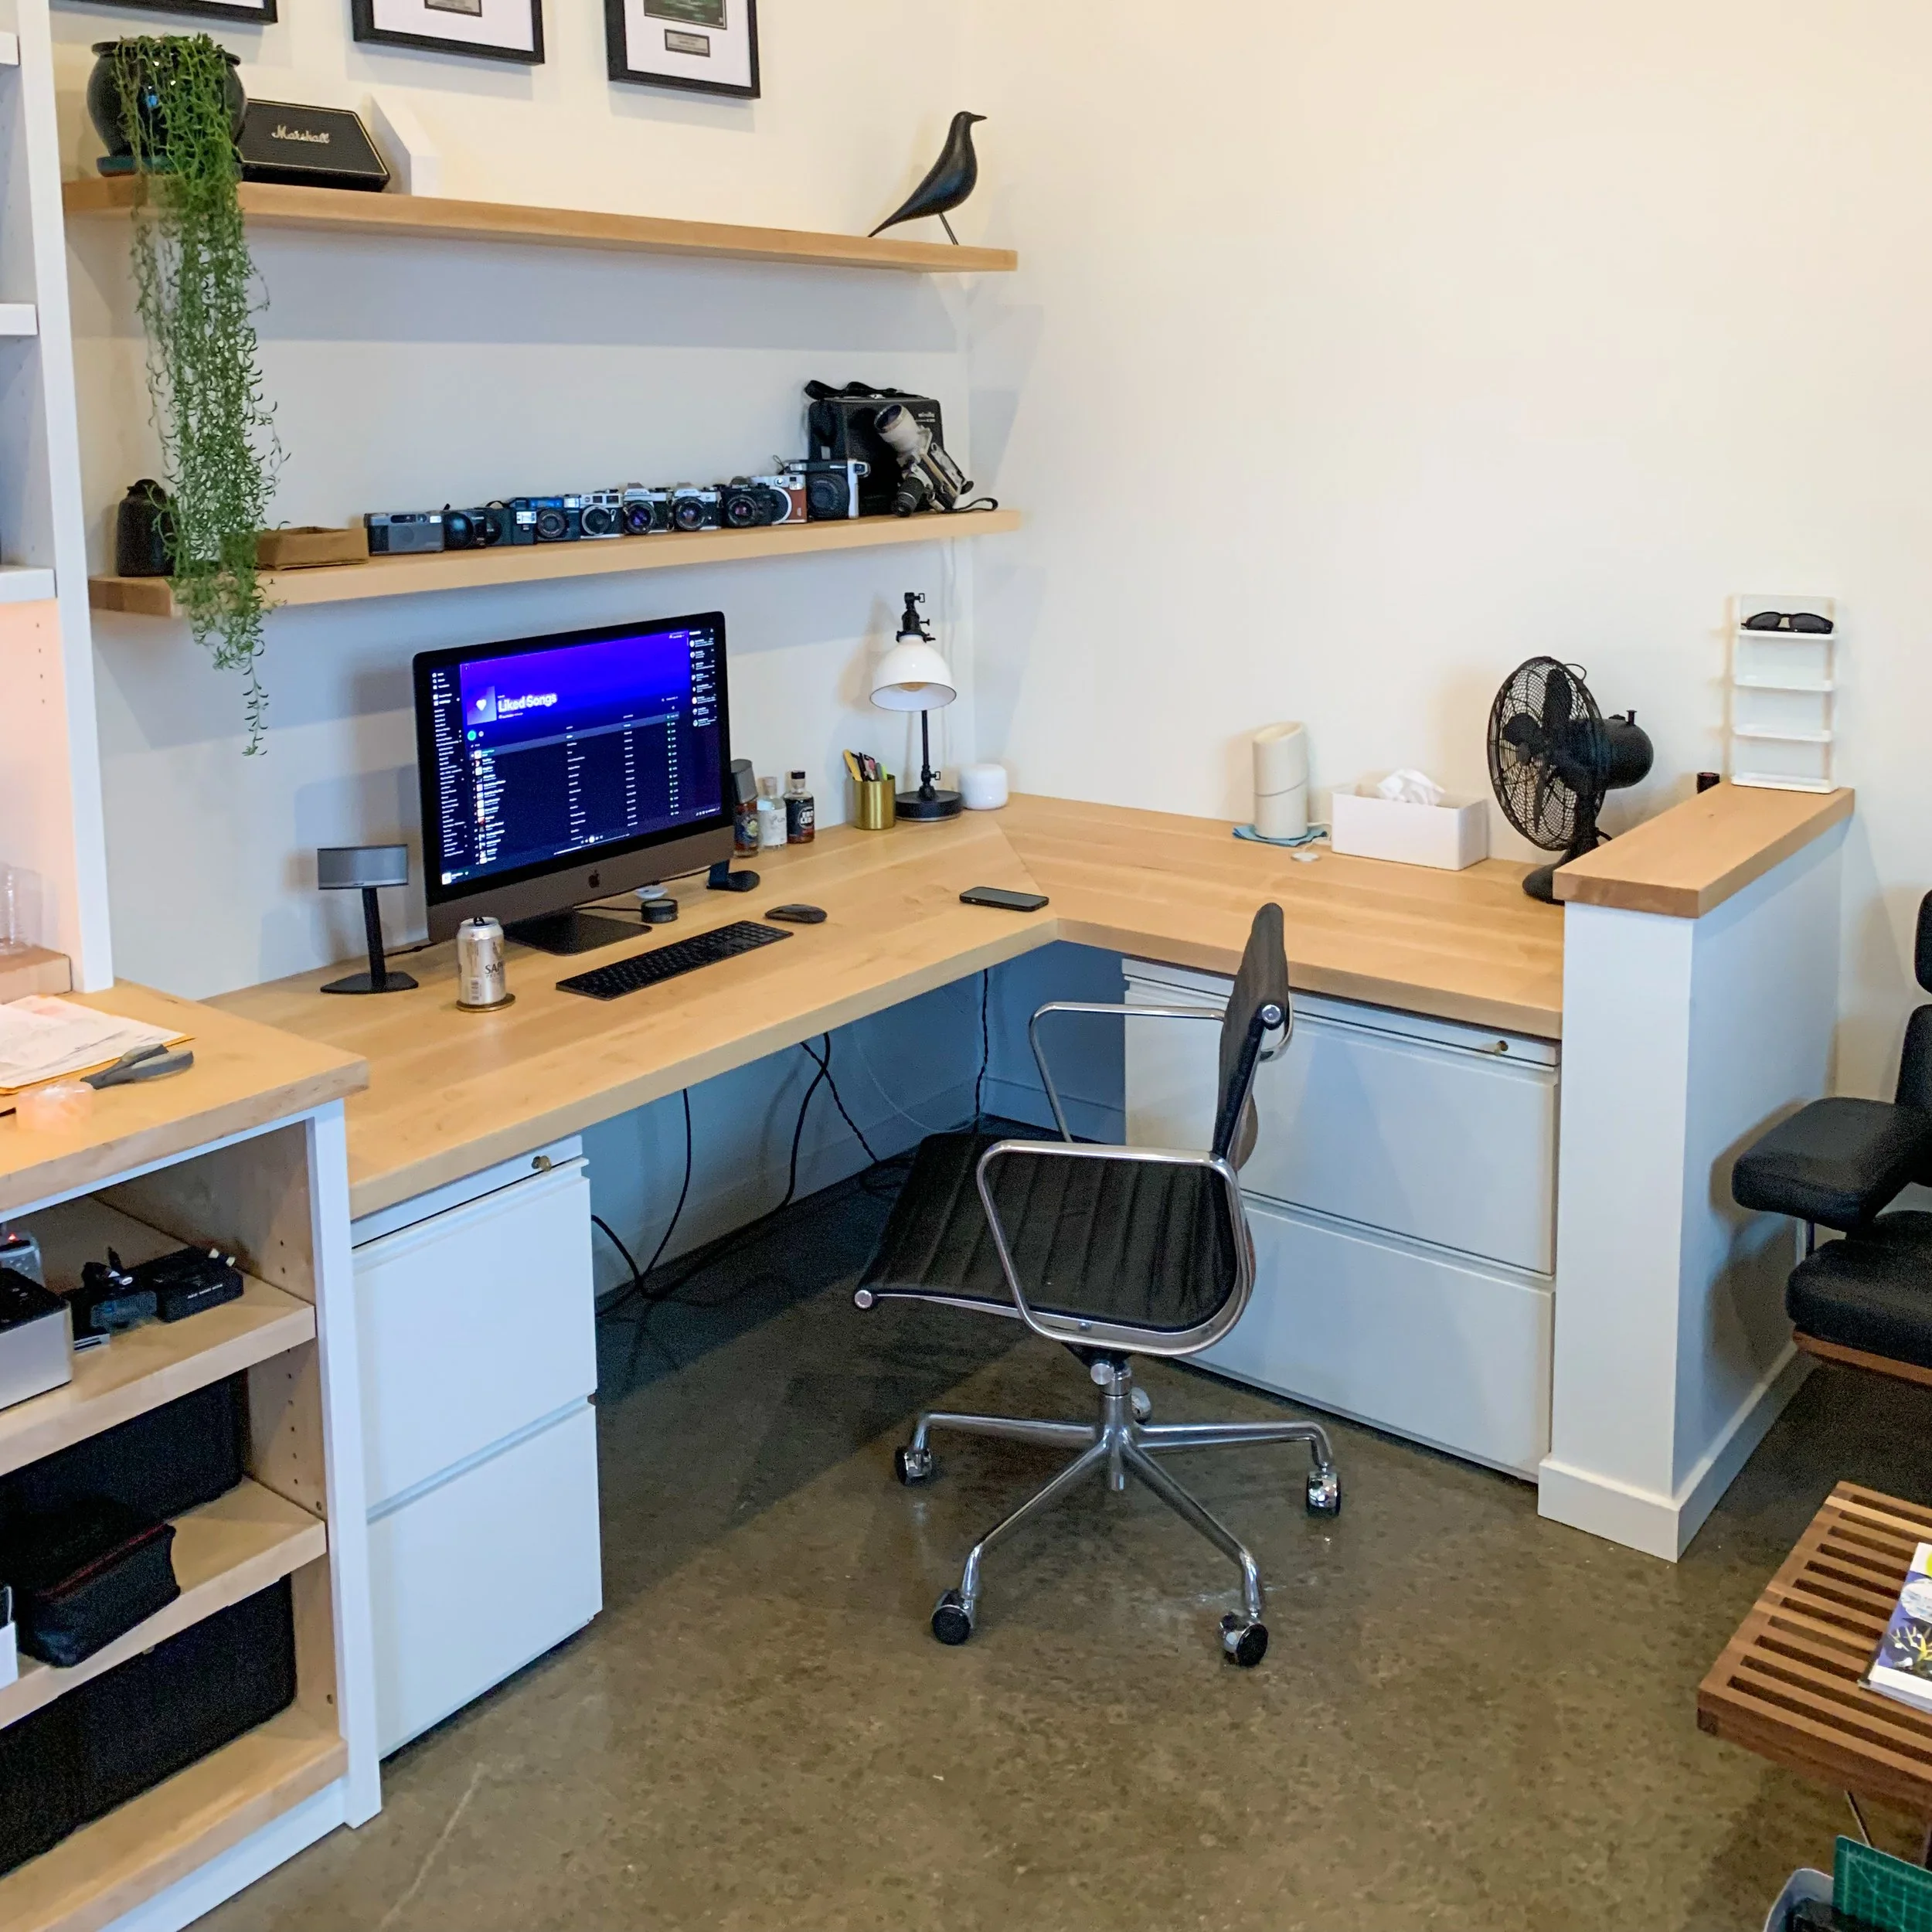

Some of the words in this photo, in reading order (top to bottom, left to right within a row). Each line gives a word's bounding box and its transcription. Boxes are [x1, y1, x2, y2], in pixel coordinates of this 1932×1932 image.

[271, 124, 330, 144] Marshall
[498, 696, 526, 713] Liked
[526, 692, 557, 707] Songs
